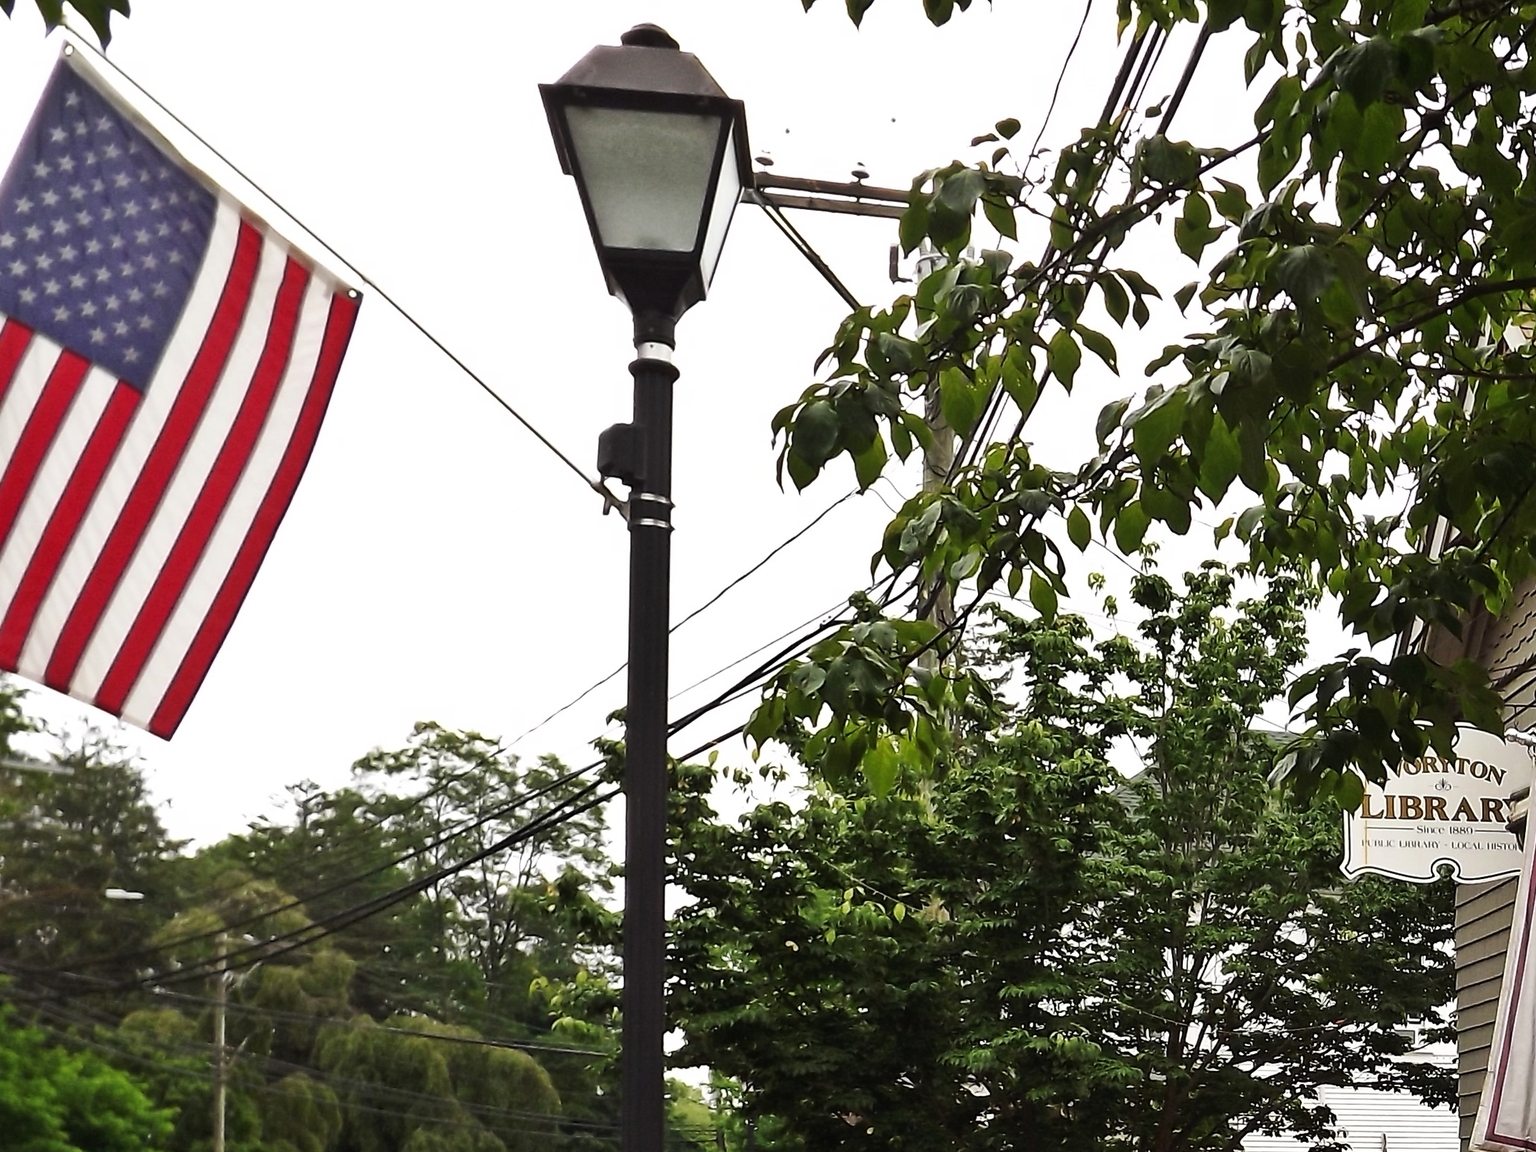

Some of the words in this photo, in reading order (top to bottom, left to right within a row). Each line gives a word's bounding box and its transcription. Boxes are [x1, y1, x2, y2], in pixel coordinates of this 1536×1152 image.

[1416, 826, 1445, 834] Since
[1361, 839, 1395, 848] PUBLIC
[1399, 840, 1441, 849] LIBRARY
[1451, 841, 1483, 850] LOCAL
[1487, 842, 1518, 851] HISTO
